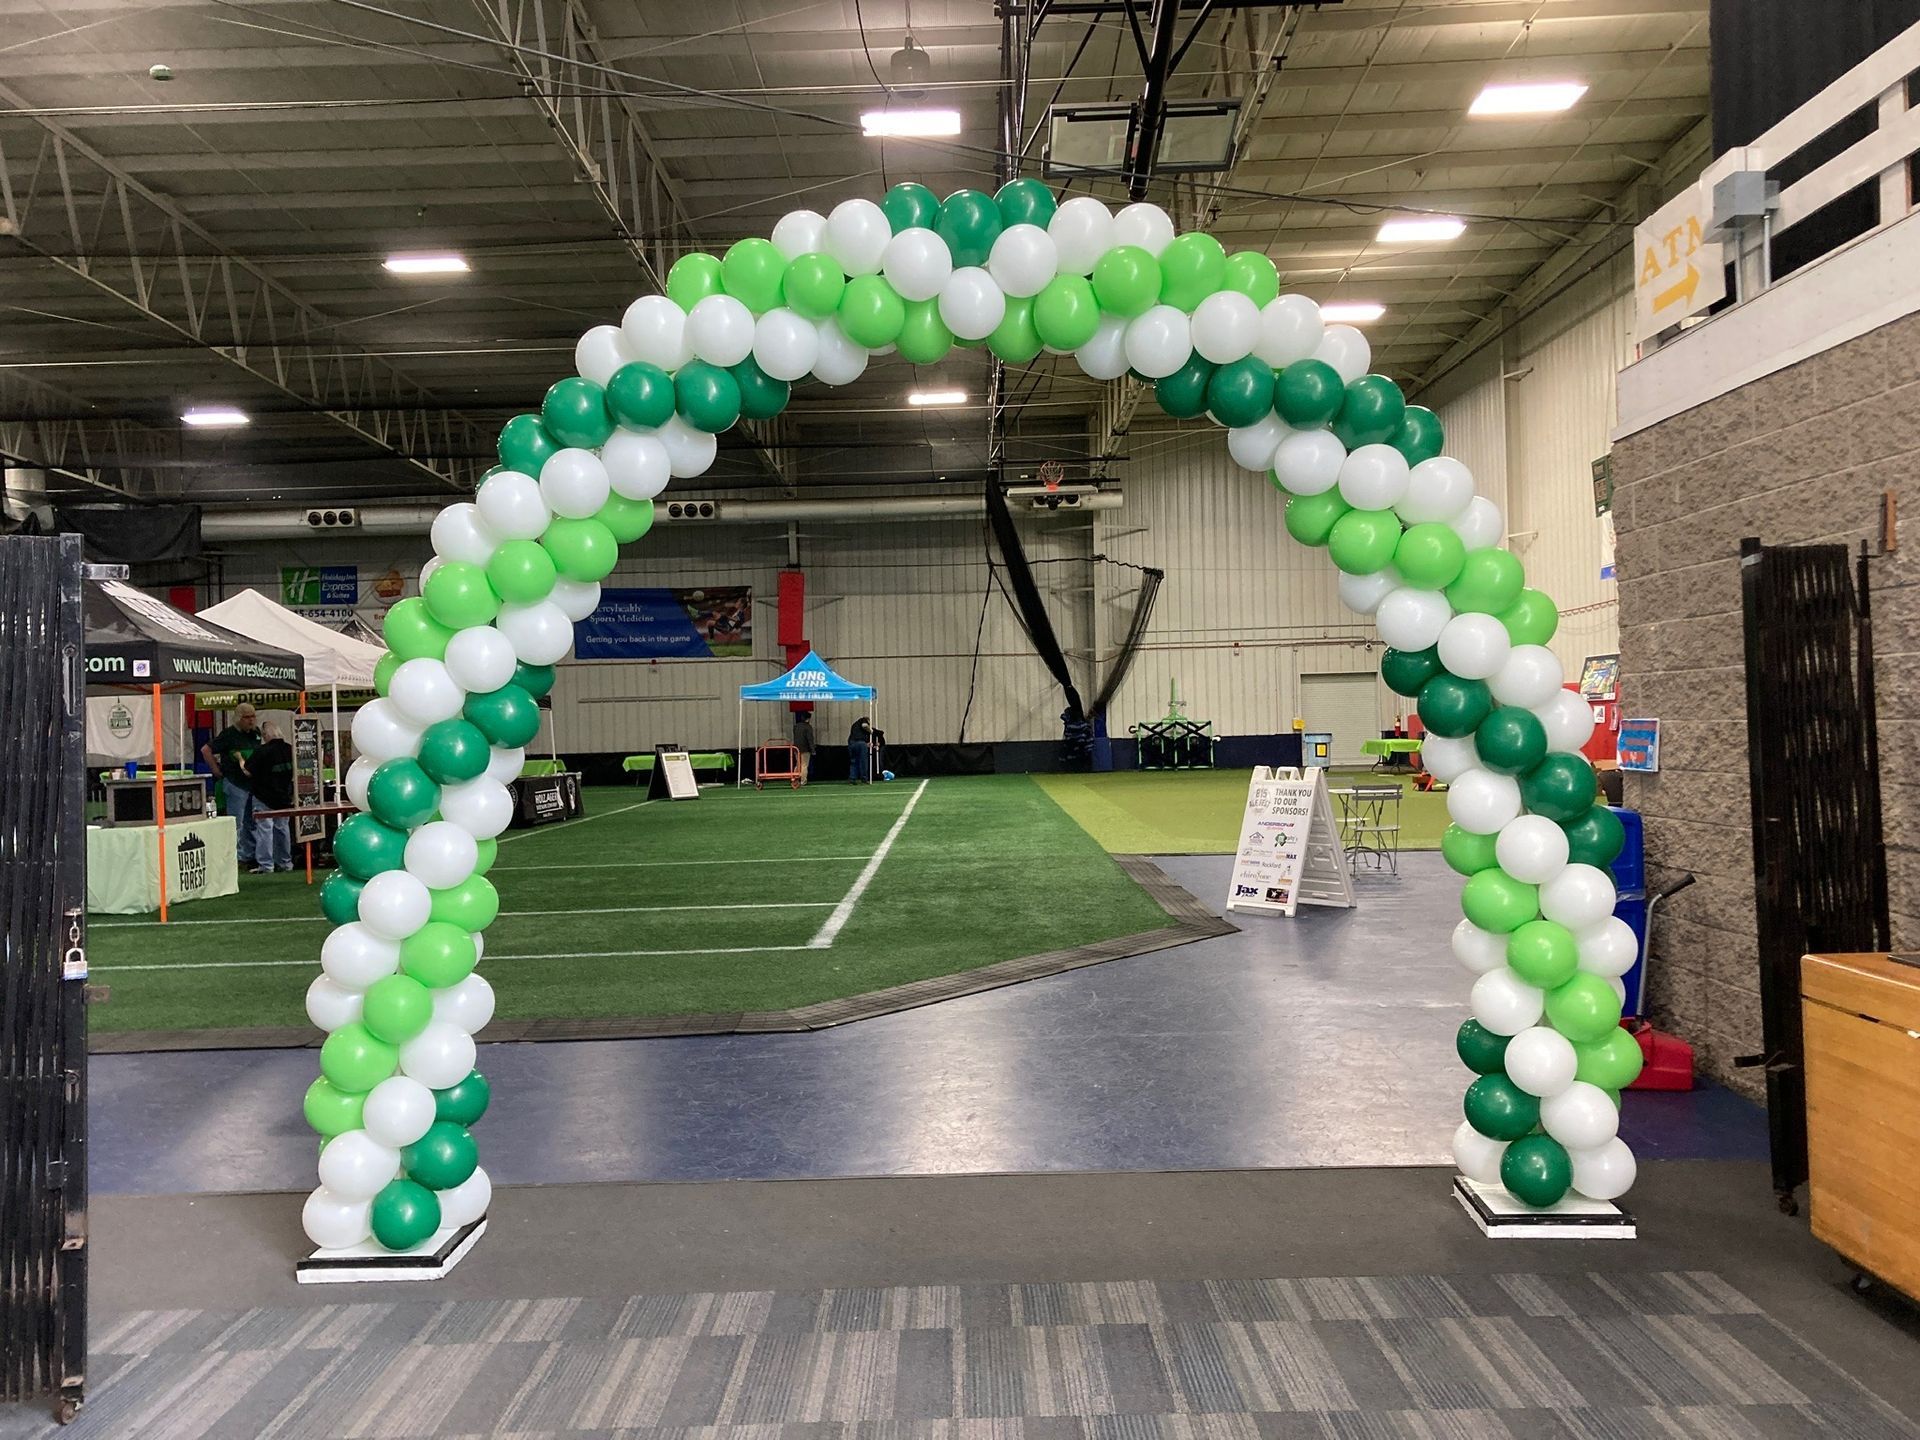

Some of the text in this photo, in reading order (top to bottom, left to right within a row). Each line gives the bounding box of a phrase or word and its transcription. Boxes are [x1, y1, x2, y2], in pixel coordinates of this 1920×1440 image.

[322, 582, 355, 592] Express
[596, 603, 641, 614] ercyhealth
[590, 614, 655, 624] Sports Medicine
[586, 635, 613, 644] Getting
[629, 635, 646, 643] back
[669, 635, 691, 643] game
[172, 656, 297, 680] www.UrbanForestBeer.com
[791, 670, 826, 681] LONG
[1275, 788, 1312, 798] THANK YOU
[1274, 797, 1298, 806] TO OUR
[1271, 806, 1309, 816] SPONSORS!
[178, 847, 206, 871] URBAN
[180, 867, 206, 891] FOREST
[1235, 884, 1259, 896] Jax
